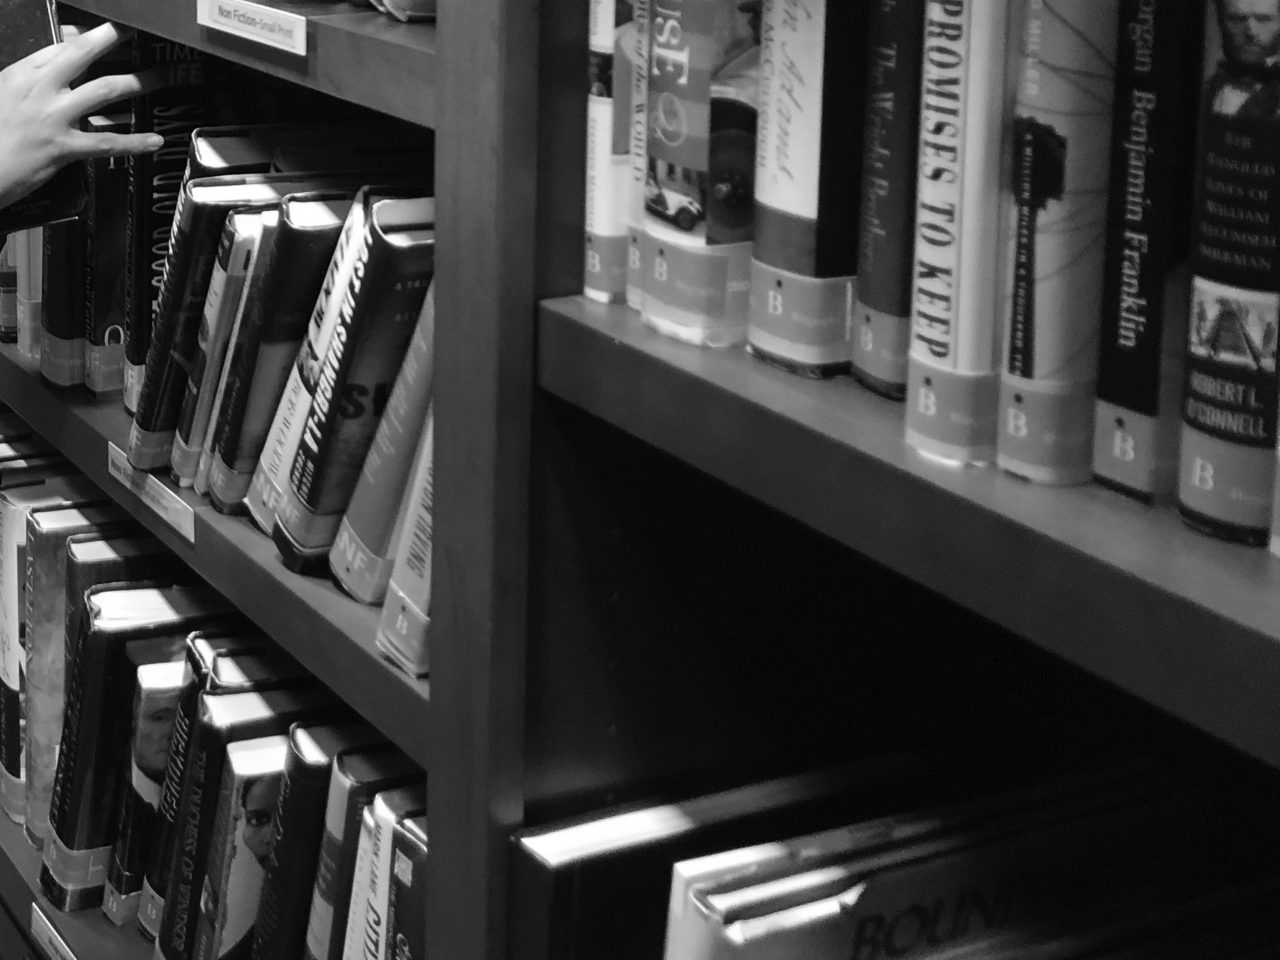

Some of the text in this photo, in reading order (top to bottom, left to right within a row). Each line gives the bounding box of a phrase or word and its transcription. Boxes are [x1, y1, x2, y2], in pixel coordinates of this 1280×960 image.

[871, 41, 897, 86] The
[775, 42, 806, 182] Adams
[919, 200, 956, 247] TO
[1118, 89, 1158, 347] Benjamin Franklin
[1205, 199, 1271, 224] WILLIAM
[587, 249, 601, 273] B
[628, 246, 641, 271] B
[653, 255, 668, 281] B
[769, 290, 784, 316] B
[916, 258, 952, 358] KEEP
[860, 325, 873, 352] B
[303, 324, 348, 454] SHANGRI-LA
[919, 388, 937, 416] B
[1190, 370, 1245, 403] ROBERT
[1006, 406, 1029, 439] B
[1113, 430, 1136, 463] B
[1188, 456, 1215, 491] B
[337, 530, 367, 570] NF
[182, 788, 204, 854] DUCHESS
[179, 856, 194, 880] OF
